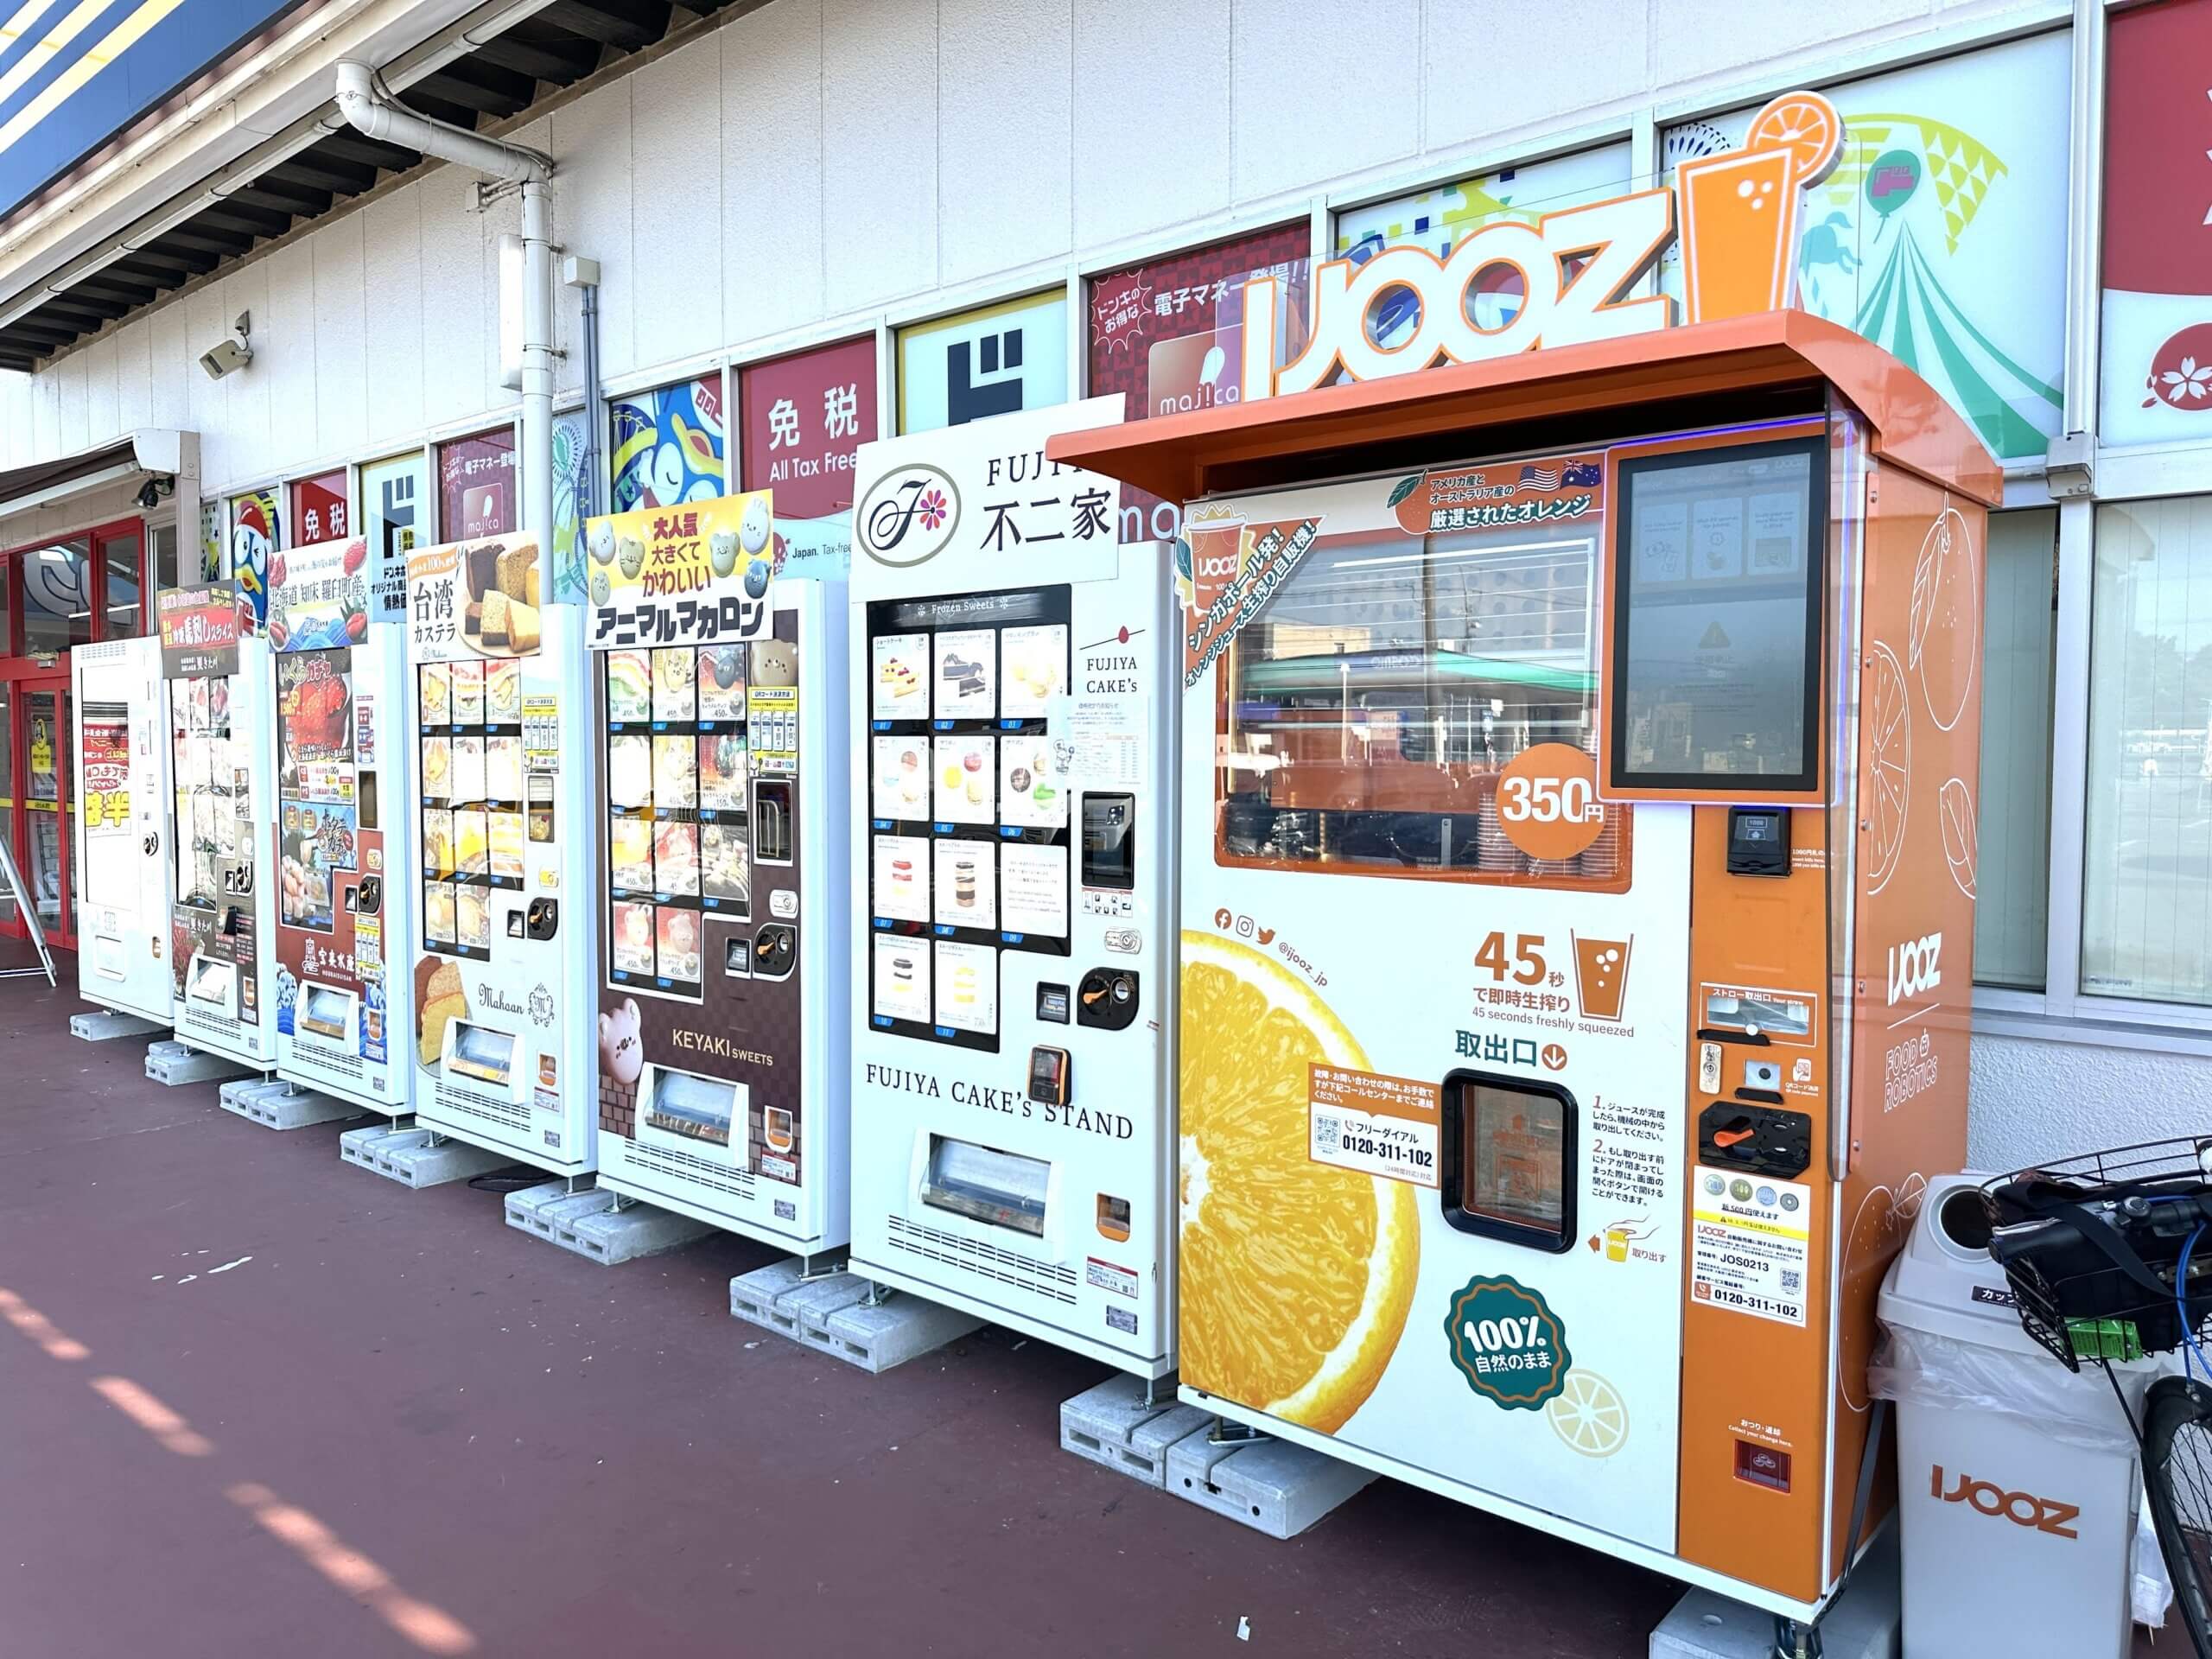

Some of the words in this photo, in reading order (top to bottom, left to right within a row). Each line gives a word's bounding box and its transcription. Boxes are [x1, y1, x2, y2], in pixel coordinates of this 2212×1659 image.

[1097, 288, 1140, 321] ドンキの
[1243, 186, 1678, 403] IJOOZ
[1104, 304, 1140, 334] お得な
[770, 458, 790, 482] All
[791, 455, 819, 477] Tax
[825, 449, 858, 473] Free
[1430, 474, 1485, 491] アメリカ産と
[1430, 486, 1514, 505] オーストラリア産の
[654, 512, 698, 541] 大人気
[980, 487, 1112, 551] 不二家
[1430, 494, 1592, 531] 厳選されたオレンジ
[652, 542, 701, 566] 大きくて
[643, 565, 711, 597] かわいい
[414, 579, 454, 622] 台湾
[931, 602, 962, 615] Frozen
[963, 601, 995, 612] Sweets
[415, 623, 455, 643] カステラ
[595, 597, 764, 645] アニマルマカロン
[1087, 657, 1137, 671] FUJIYA
[1087, 677, 1138, 693] CAKE's
[1502, 776, 1605, 823] 350円
[1279, 941, 1329, 989] @ijooz_jp
[1888, 931, 1942, 1007] IJOOZ
[479, 982, 524, 1015] Mahoan
[1473, 987, 1571, 1013] で即時生搾り
[1713, 988, 1771, 1002] ストロー取出口
[1472, 1007, 1486, 1019] 45
[1488, 1009, 1534, 1025] seconds
[1535, 1014, 1575, 1033] freshly
[1578, 1020, 1636, 1039] squeezed
[673, 1028, 730, 1058] KEYAKI
[732, 1048, 773, 1066] SWEETS
[1455, 1028, 1538, 1068] 取出口
[1885, 1038, 1917, 1080] FOOD
[1884, 1055, 1937, 1113] ROBOTICS
[867, 1063, 941, 1098] FUJIYA
[951, 1081, 1033, 1118] CAKE's
[1045, 1103, 1134, 1140] STAND
[1356, 1122, 1419, 1144] フリーダイアル
[1592, 1122, 1663, 1141] 取り出してください。
[1343, 1135, 1433, 1167] 0120-311-102
[1592, 1188, 1648, 1206] ことができます。
[1632, 1248, 1667, 1263] 取り出す
[1719, 1254, 1770, 1272] JOS0213
[1714, 1289, 1798, 1318] 0120-311-102
[1464, 1315, 1547, 1353] 100%
[1475, 1351, 1552, 1374] 自然のまま
[1930, 1464, 2081, 1540] IJOOZ
